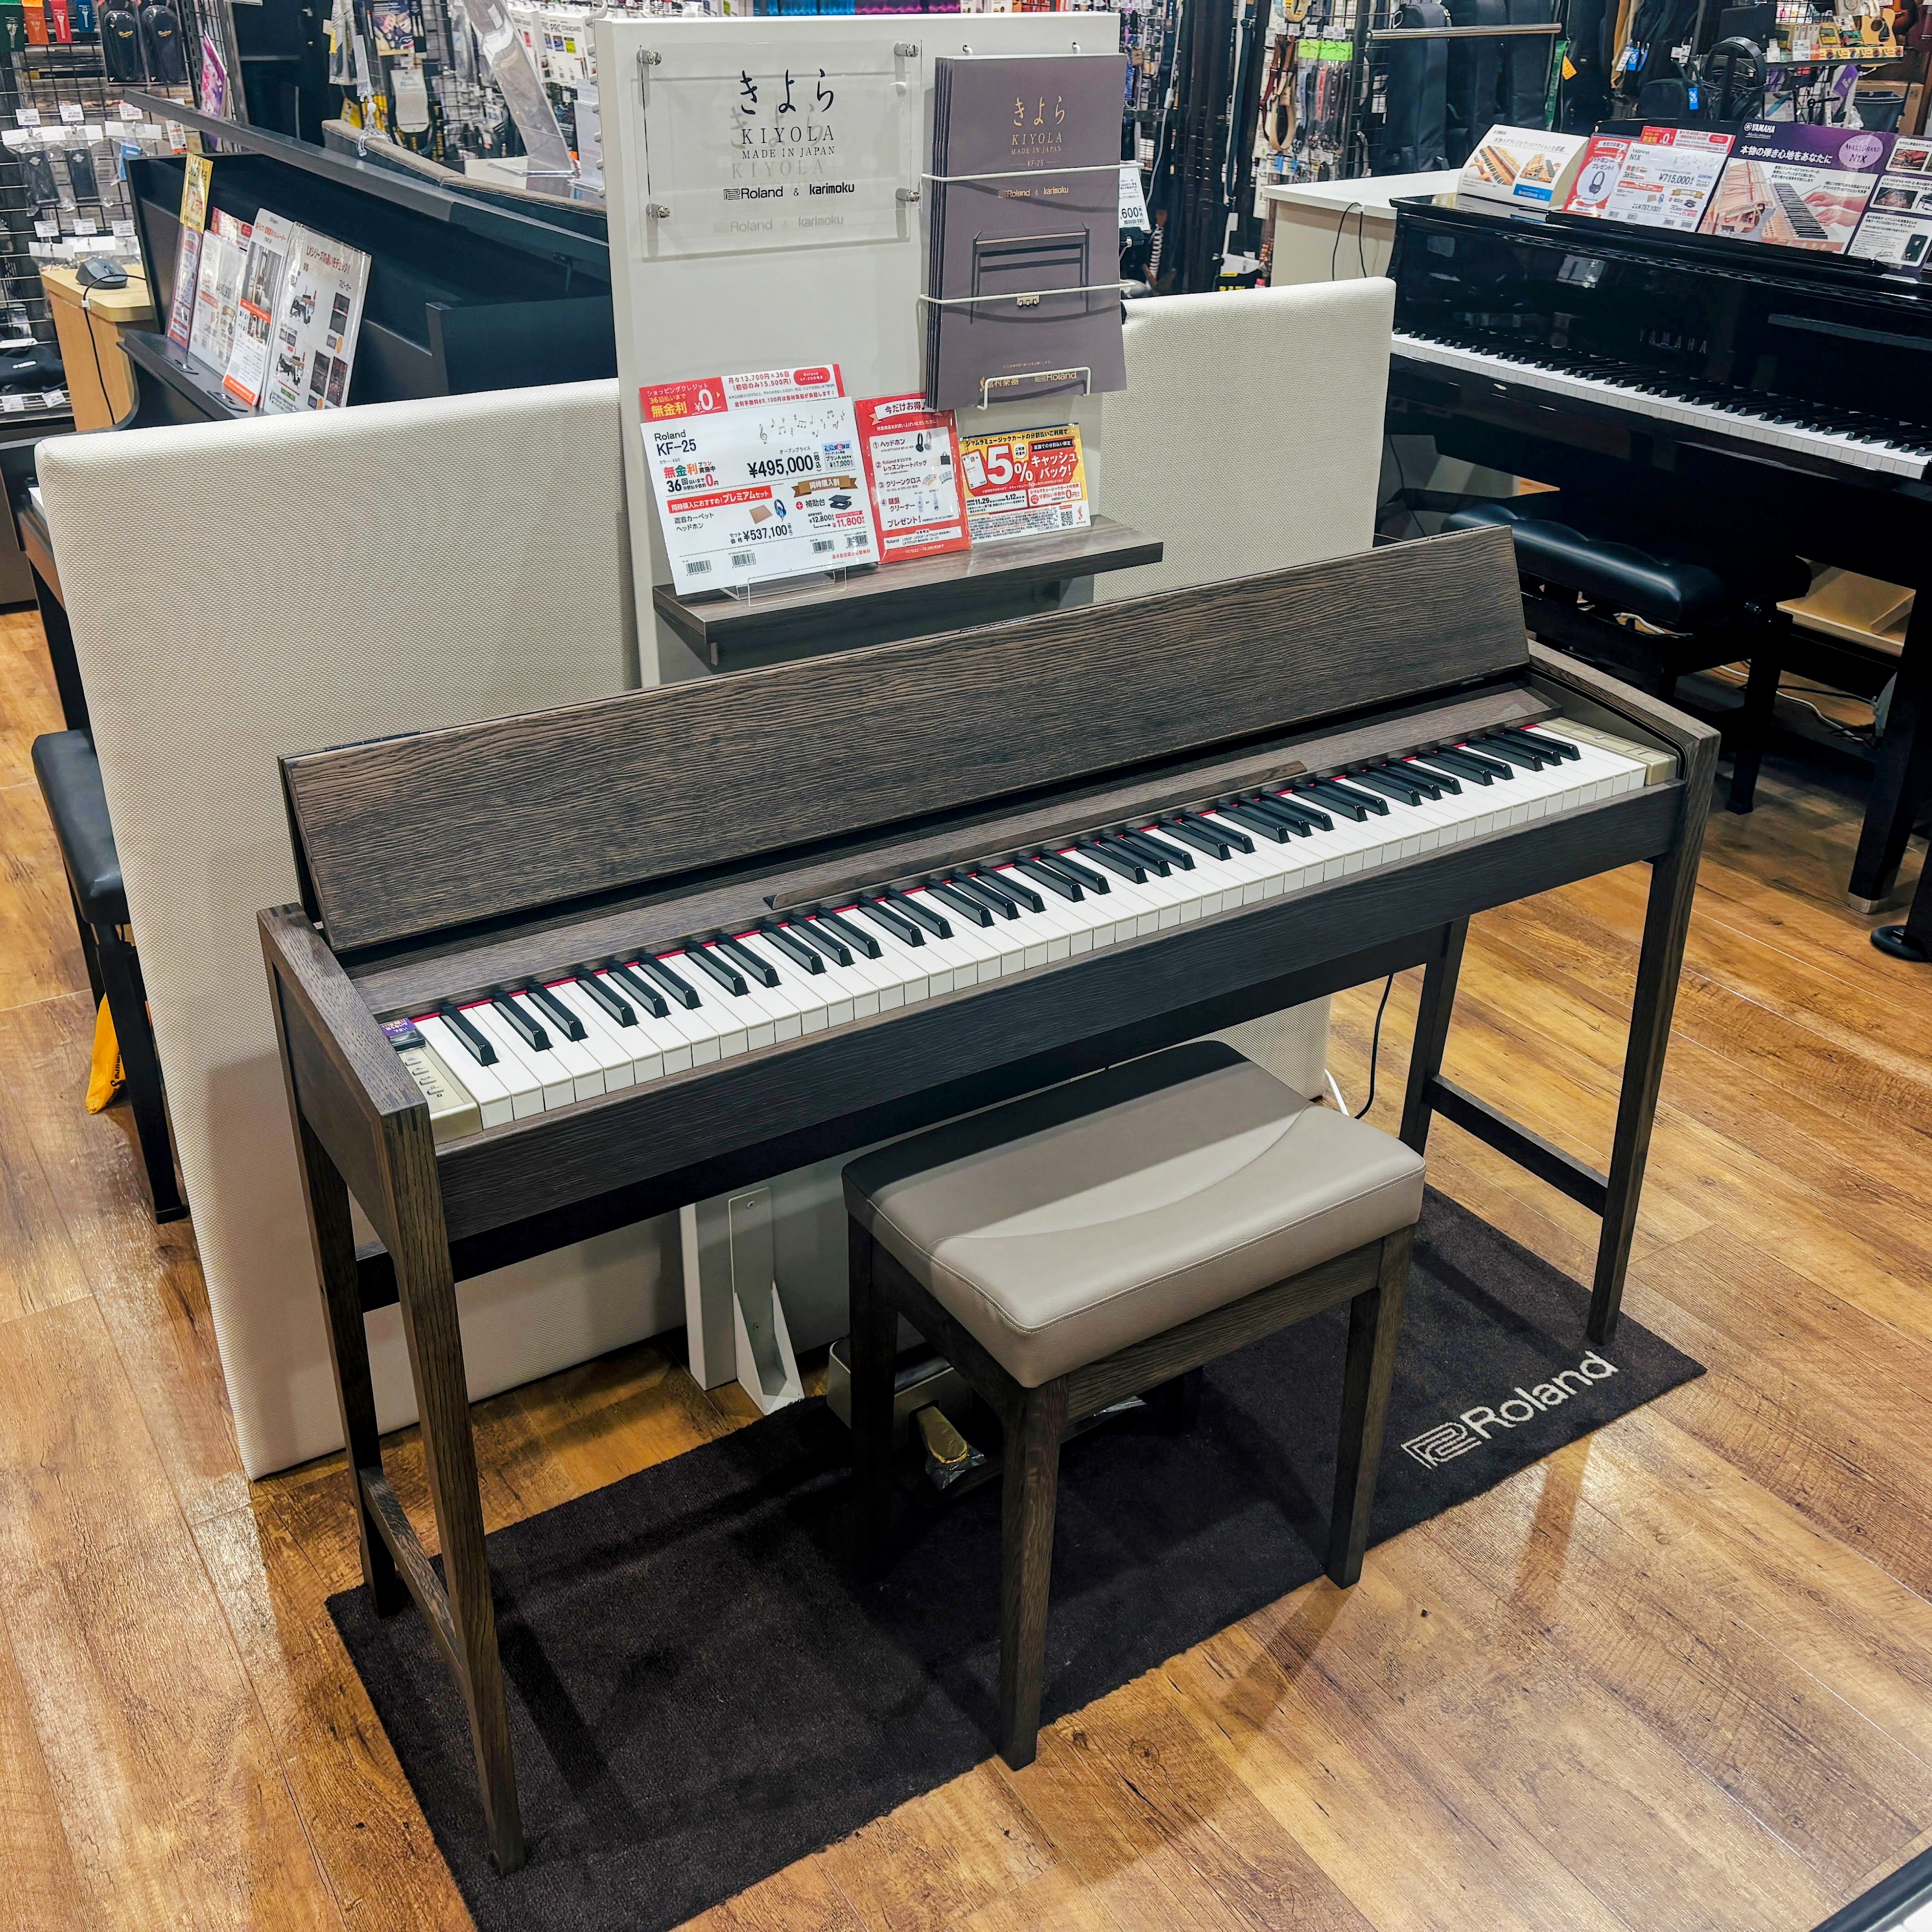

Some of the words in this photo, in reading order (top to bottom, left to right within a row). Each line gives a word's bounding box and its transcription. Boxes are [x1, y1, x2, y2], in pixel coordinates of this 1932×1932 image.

[740, 69, 834, 115] きよら
[1014, 96, 1066, 126] きよら
[742, 125, 835, 144] KIYOLA
[1752, 123, 1776, 134] YAMAHA
[1012, 132, 1062, 145] KIYOLA
[742, 149, 776, 159] MADE
[783, 148, 794, 157] IN
[800, 146, 835, 157] JAPAN
[1740, 145, 1833, 164] 本物の弾き心地をあなたに
[1659, 173, 1690, 185] ¥715,000
[741, 186, 783, 199] Roland
[794, 188, 799, 196] &
[810, 182, 854, 195] karimoku
[1007, 188, 1031, 197] Roland
[1043, 186, 1069, 195] karimoku
[1046, 371, 1077, 382] Roland
[647, 383, 708, 396] ショッピングクレジット
[649, 393, 686, 404] 36回払いまで
[651, 401, 688, 418] 無金利
[885, 401, 921, 414] 今だけお得
[654, 430, 686, 441] Roland
[657, 439, 696, 456] KF-25
[779, 446, 811, 454] オープンプライス
[747, 455, 813, 478] ¥495,000
[884, 459, 927, 471] レッスントートバッグ
[1031, 453, 1077, 467] キャッシュ
[664, 462, 699, 479] 無金利
[1040, 465, 1072, 479] バック!
[886, 477, 921, 488] クリーンクロス
[806, 499, 825, 508] 補助台
[890, 503, 915, 512] クリーナー
[809, 514, 832, 523] ¥12,800
[832, 516, 862, 528] ¥11,800
[888, 516, 921, 527] プレゼント!
[677, 523, 704, 532] ヘッドホン
[743, 525, 787, 541] ¥537,100
[1460, 1350, 1619, 1439] Roland
